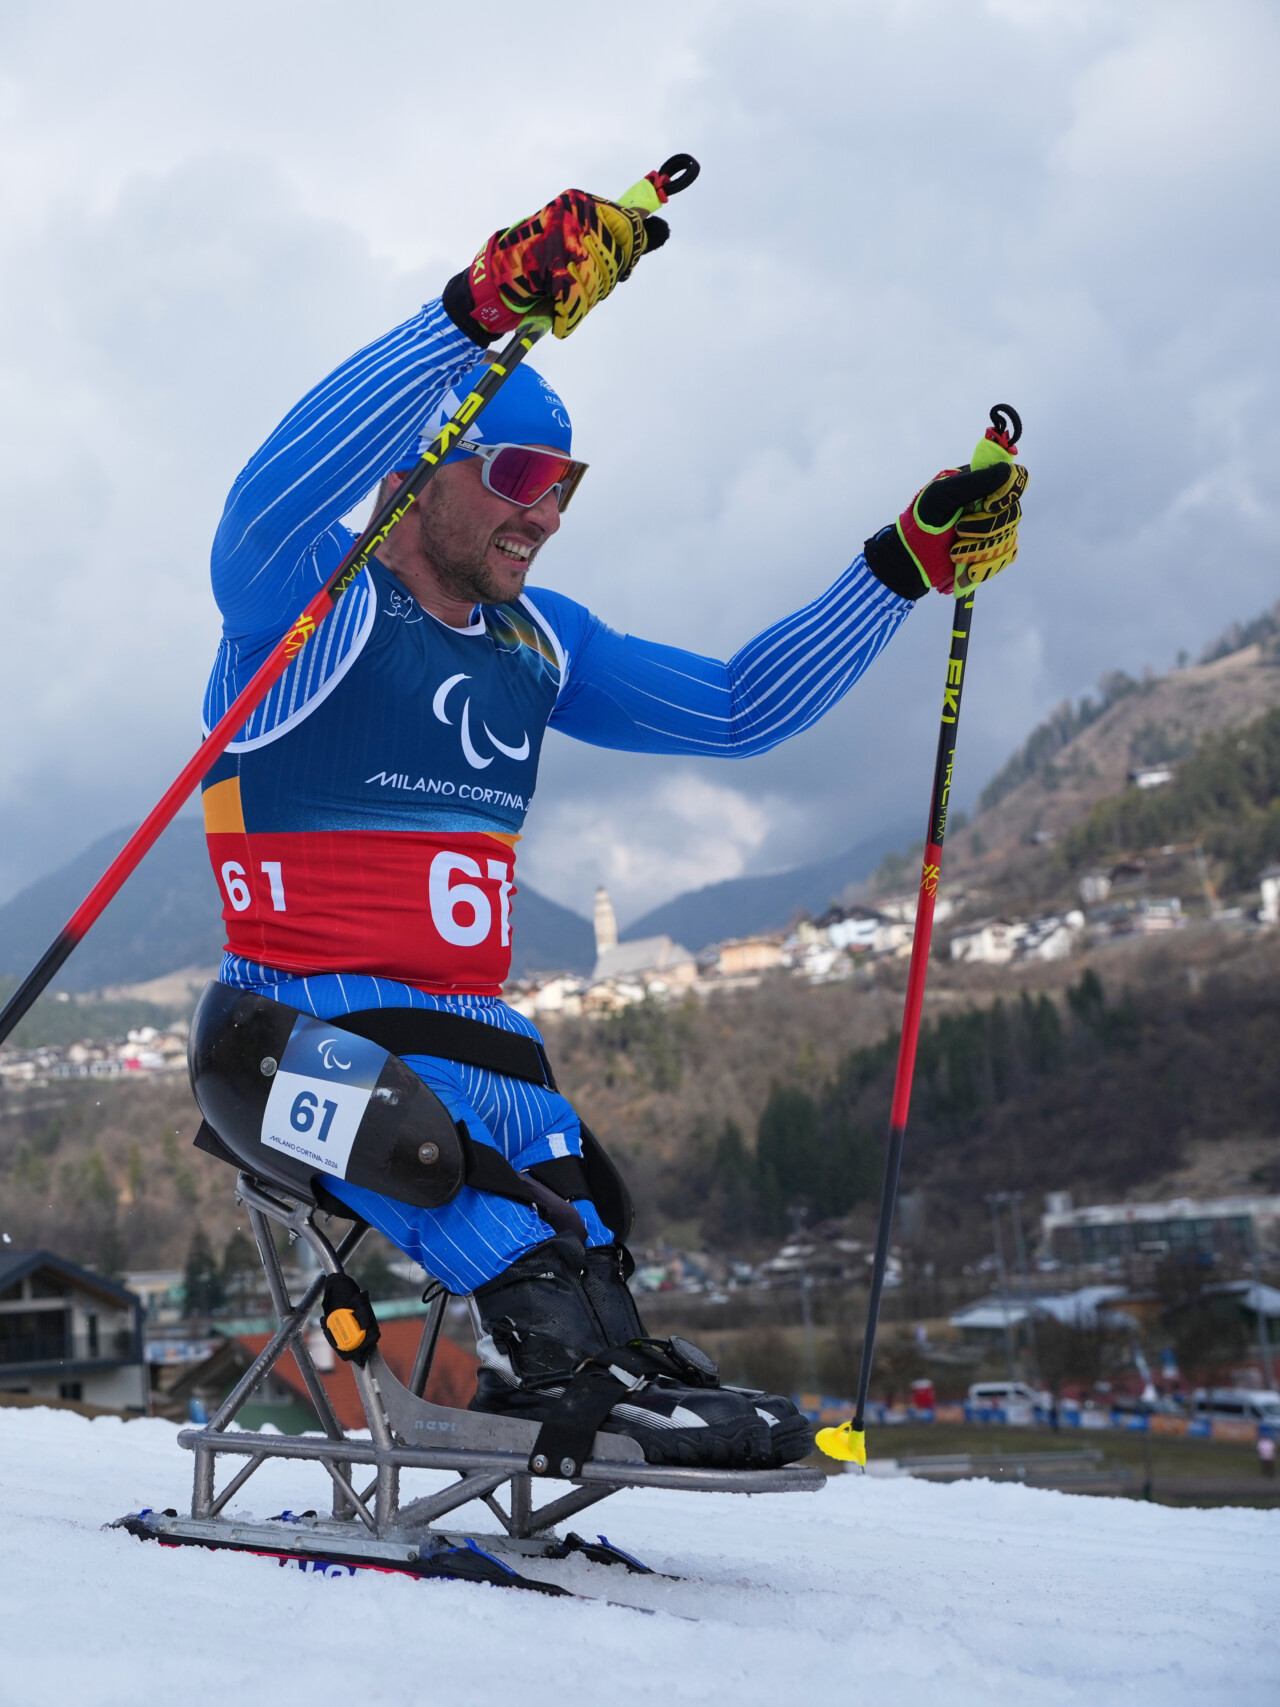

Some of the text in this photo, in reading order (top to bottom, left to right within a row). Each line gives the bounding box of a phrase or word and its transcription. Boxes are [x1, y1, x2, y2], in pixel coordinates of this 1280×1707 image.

[941, 629, 967, 724] LEKI
[364, 771, 456, 796] MILANO
[458, 784, 524, 810] CORTINA
[221, 860, 287, 912] 61
[428, 850, 513, 947] 61
[290, 1090, 338, 1143] 61
[269, 1135, 338, 1169] MILANO CORTINA 2026
